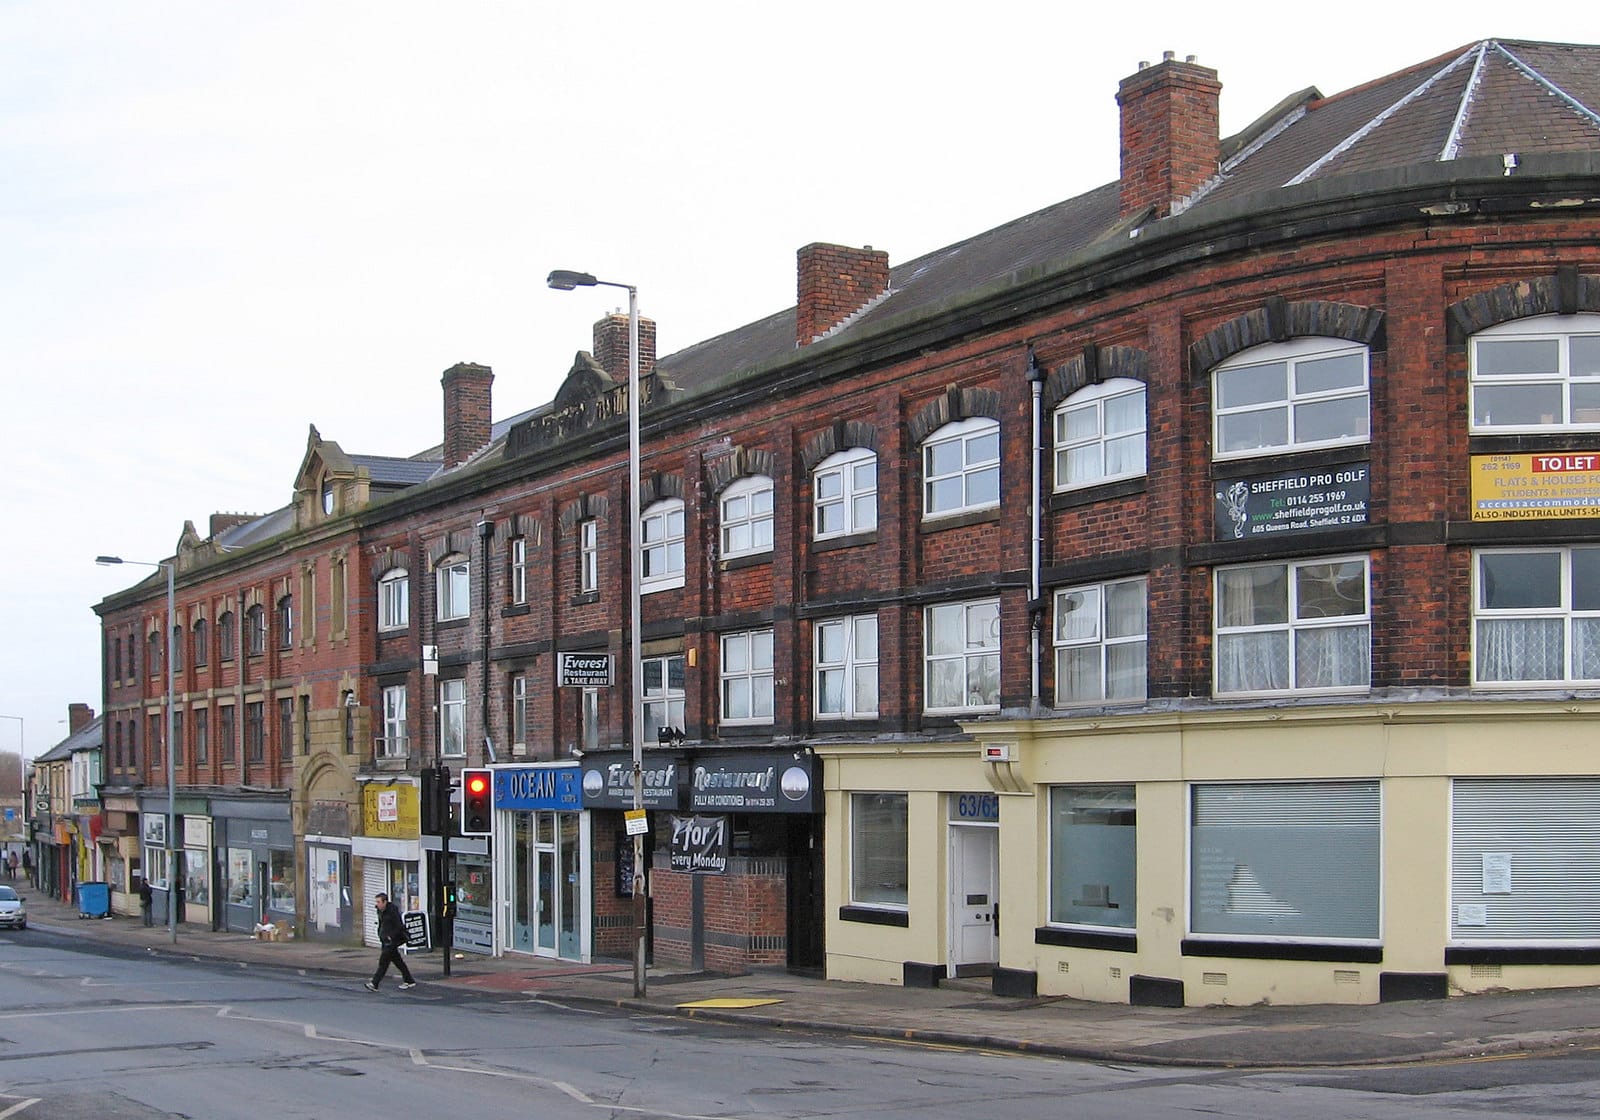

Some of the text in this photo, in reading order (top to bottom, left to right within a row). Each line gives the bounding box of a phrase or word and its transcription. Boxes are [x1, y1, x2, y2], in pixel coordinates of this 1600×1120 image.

[1538, 457, 1595, 470] TO LET
[1251, 470, 1365, 493] SHEFFIELD PRO GOLF
[1494, 477, 1528, 487] FLATS
[1531, 477, 1538, 486] &
[1542, 475, 1586, 485] HOUSES
[1287, 495, 1308, 506] 0114
[1309, 493, 1324, 504] 255
[1326, 491, 1346, 502] 1969
[1502, 489, 1549, 498] STUDENTS
[1266, 522, 1290, 532] Queens
[1341, 515, 1350, 524] S2
[1352, 513, 1366, 522] 4DX
[564, 655, 607, 668] Everest
[564, 669, 607, 677] Restaurant
[511, 771, 556, 799] OCEAN
[694, 767, 774, 792] Restaurant
[643, 788, 673, 797] RESTAURANT
[694, 795, 707, 806] FULLY
[707, 795, 715, 806] AIR
[715, 795, 744, 806] CONDITIONED
[682, 818, 712, 851] for
[716, 820, 725, 846] 1
[692, 852, 726, 871] Monday
